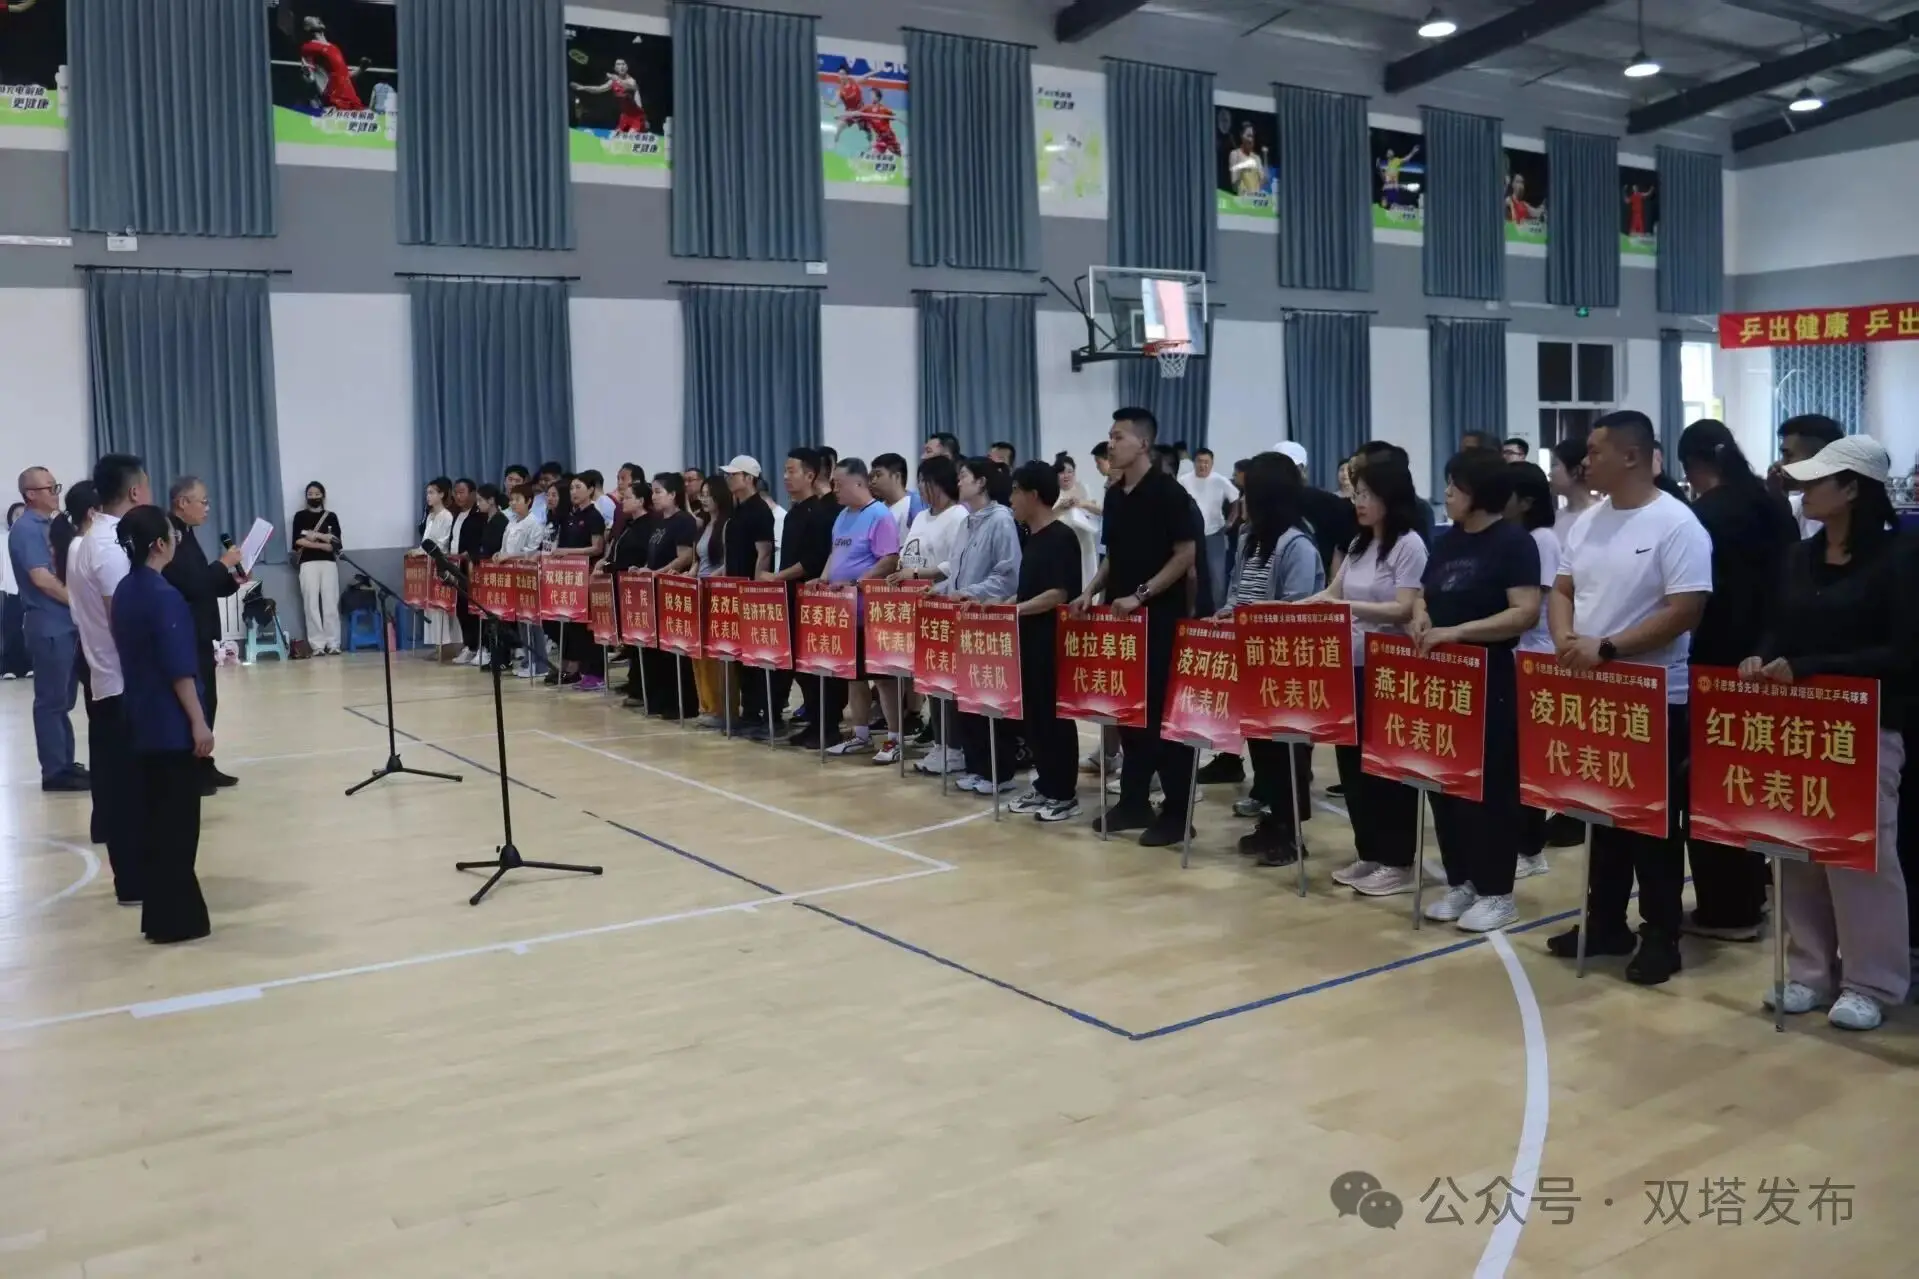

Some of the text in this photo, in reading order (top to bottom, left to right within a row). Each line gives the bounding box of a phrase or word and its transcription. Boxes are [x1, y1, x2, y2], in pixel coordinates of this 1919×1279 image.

[1739, 307, 1919, 344] 乒出健康 乒出
[550, 589, 578, 607] 代表队
[665, 592, 693, 614] 税务局
[743, 603, 784, 622] 经济开发区
[868, 600, 915, 624] 孙家湾
[626, 611, 650, 629] 代表队
[666, 616, 693, 637] 代表队
[710, 620, 741, 640] 代表队
[800, 605, 850, 629] 区委联合
[750, 627, 779, 645] 代表队
[806, 632, 844, 655] 代表队
[960, 629, 1013, 657] 桃花吐镇
[1064, 630, 1137, 661] 他拉皋镇
[1244, 636, 1341, 668] 前进街道
[968, 663, 1008, 690] 代表队
[1072, 667, 1128, 697] 代表队
[1374, 666, 1473, 716] 燕北街道
[1180, 686, 1230, 720] 代表队
[1260, 677, 1331, 710] 代表队
[1530, 688, 1652, 743] 凌凤街道
[1384, 712, 1458, 759] 代表队
[1706, 707, 1857, 765] 红旗街道
[1545, 739, 1636, 790] 代表队
[1722, 763, 1836, 819] 代表队
